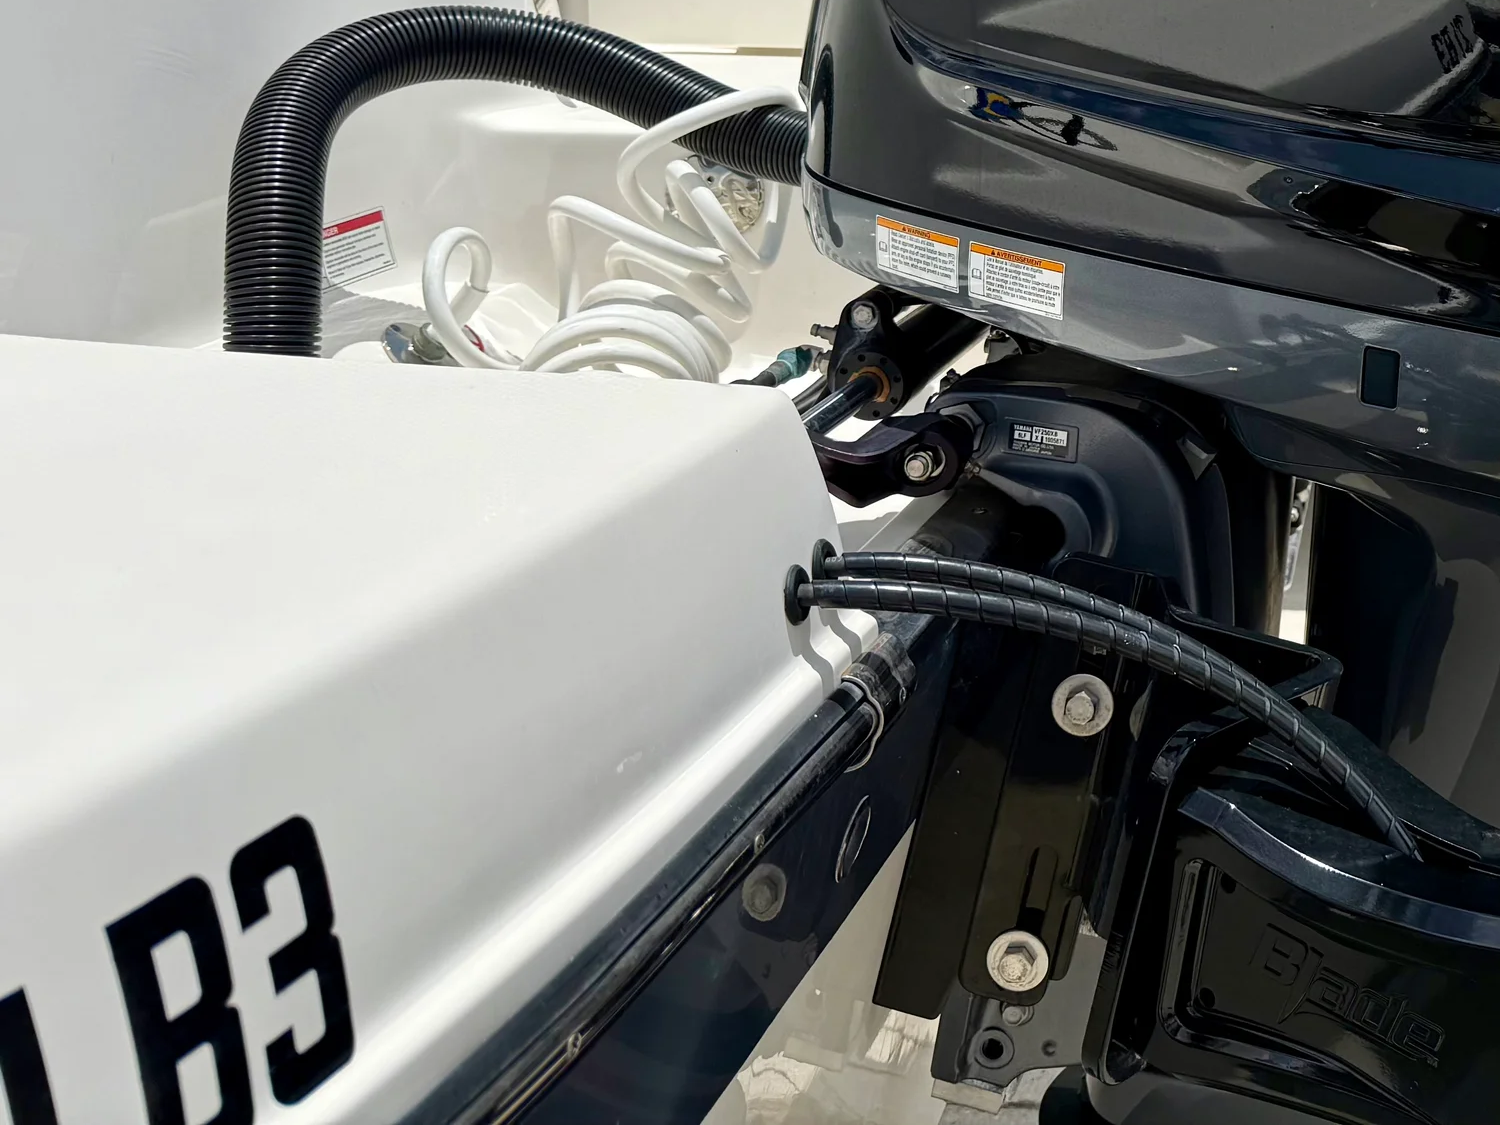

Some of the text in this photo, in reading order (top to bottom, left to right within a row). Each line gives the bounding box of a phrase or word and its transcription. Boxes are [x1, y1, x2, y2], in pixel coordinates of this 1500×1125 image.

[907, 227, 931, 239] WARNING
[996, 250, 1043, 267] AVERTISSEMENT
[1247, 921, 1447, 1062] Blade
